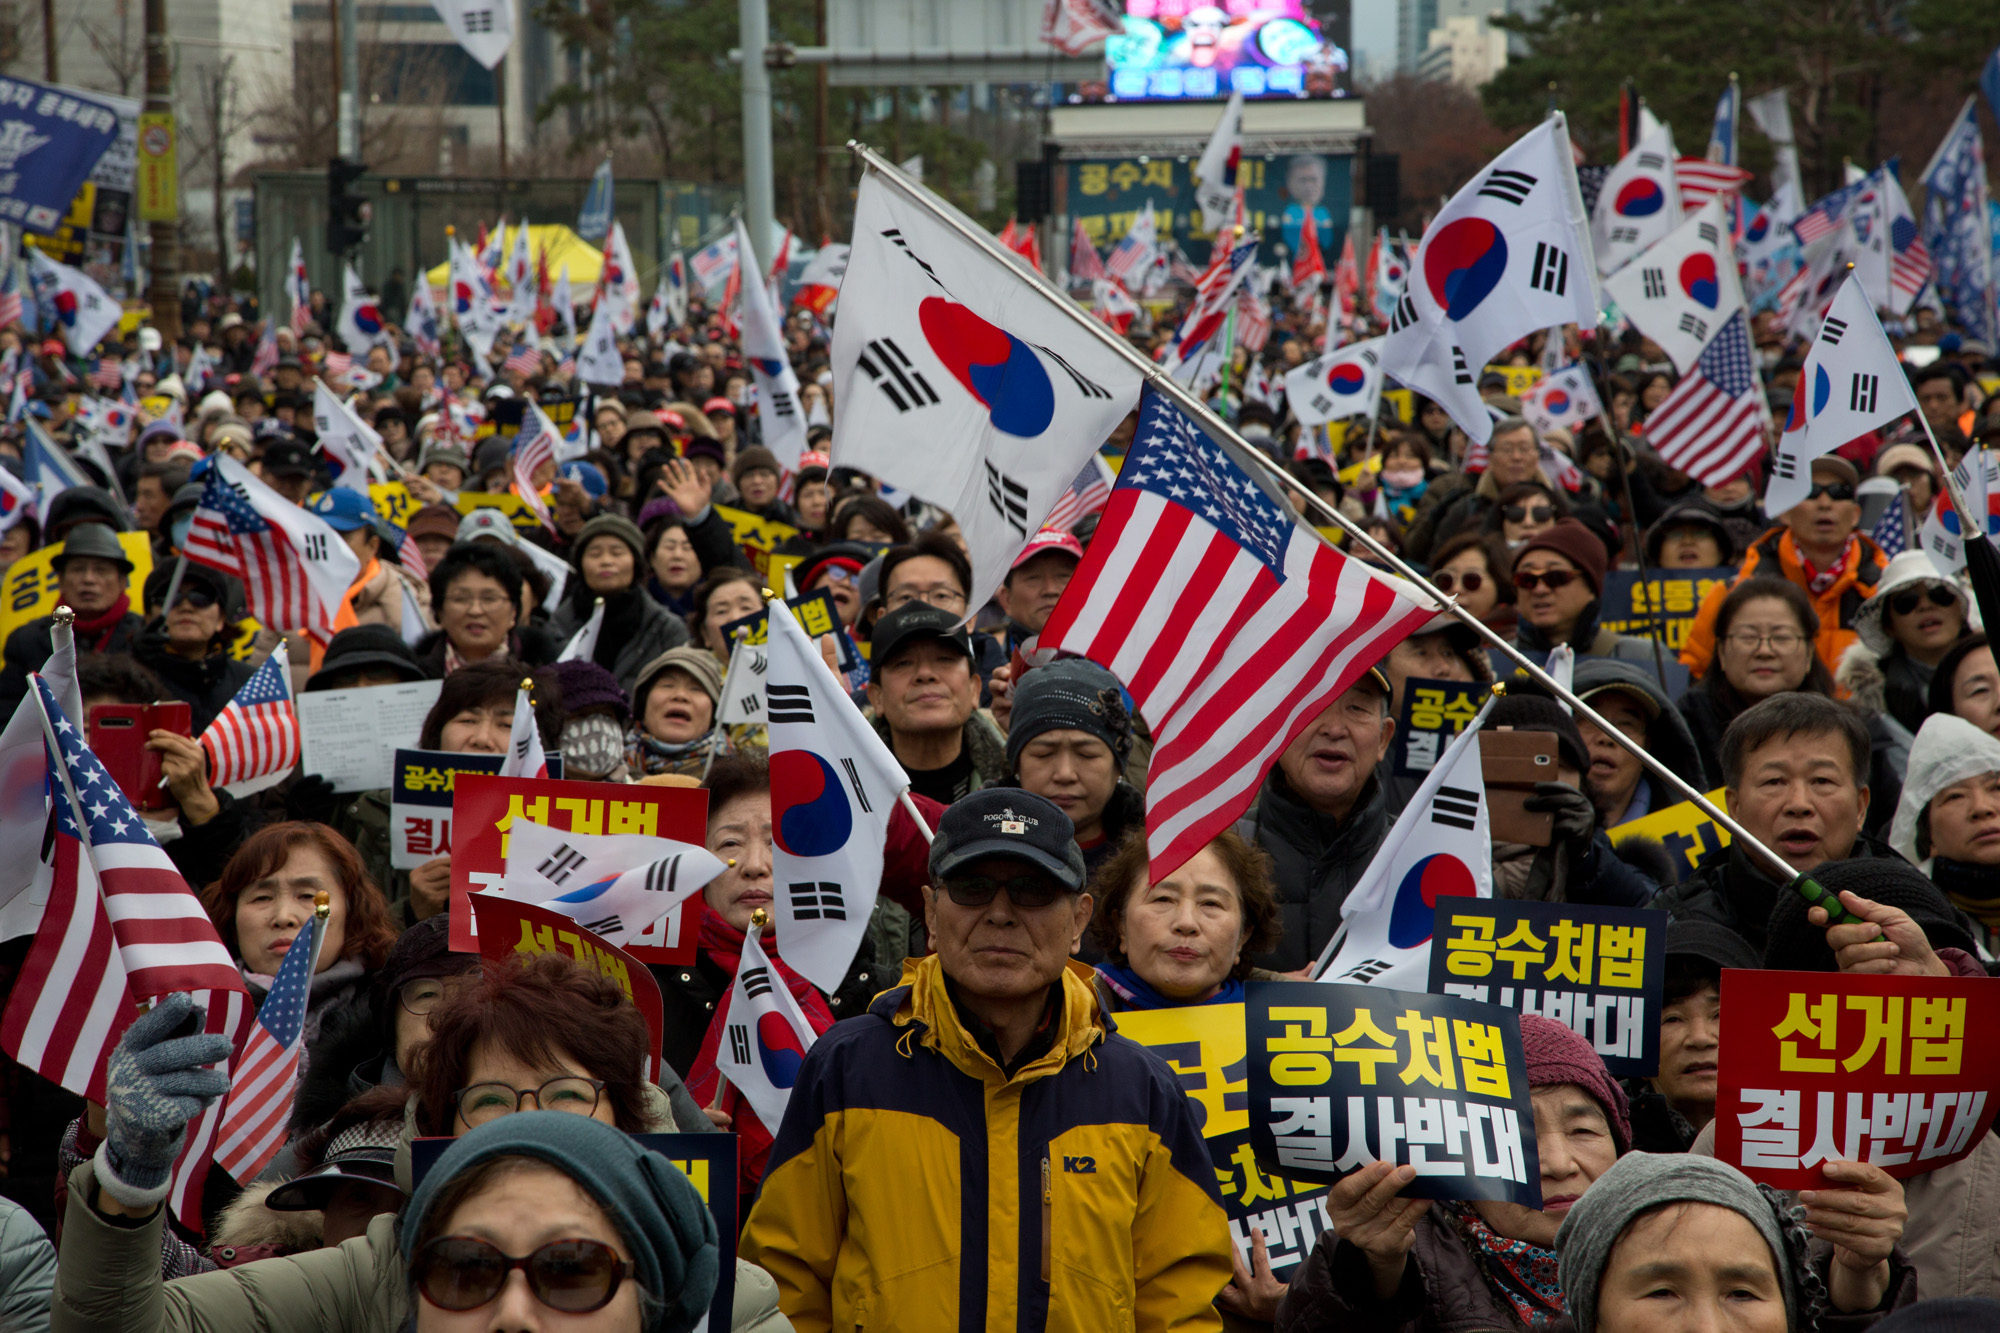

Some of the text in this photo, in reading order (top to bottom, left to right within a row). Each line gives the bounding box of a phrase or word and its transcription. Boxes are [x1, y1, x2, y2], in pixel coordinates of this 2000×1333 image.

[1018, 814, 1039, 826] CLUB
[1446, 914, 1647, 989] 공수처법
[1266, 1006, 1512, 1099] 공수처법
[1771, 992, 1967, 1075] 선거법
[1063, 1156, 1097, 1173] K2
[1268, 1096, 1528, 1184] 결사반대
[1736, 1088, 1989, 1170] 결사반대
